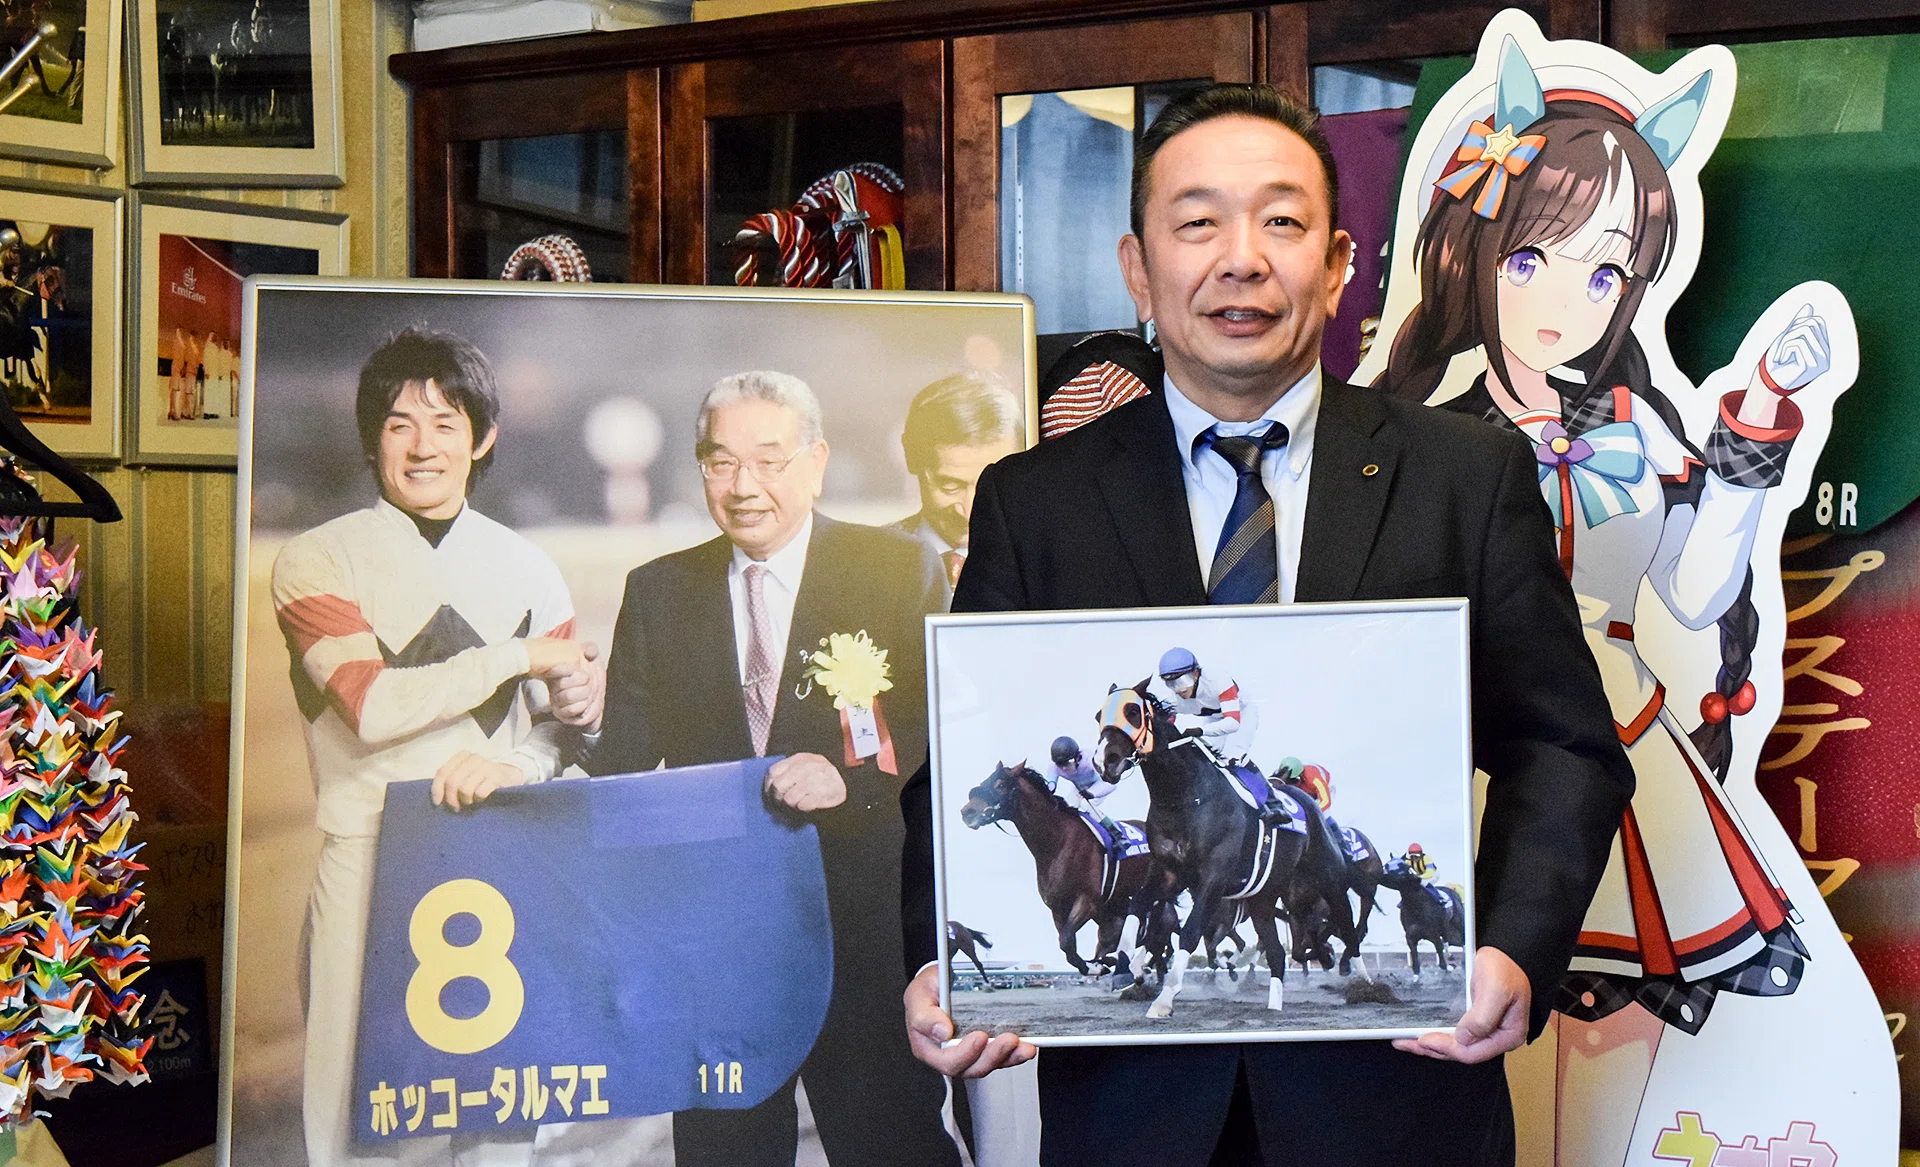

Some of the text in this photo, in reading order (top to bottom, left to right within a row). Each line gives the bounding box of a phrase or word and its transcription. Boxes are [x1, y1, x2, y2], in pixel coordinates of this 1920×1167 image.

[171, 282, 207, 304] Emirates
[1815, 481, 1858, 526] 8R
[405, 878, 524, 1055] 8
[145, 989, 191, 1050] 念
[369, 1064, 609, 1136] ホッコータルマエ
[698, 1062, 743, 1094] 11R
